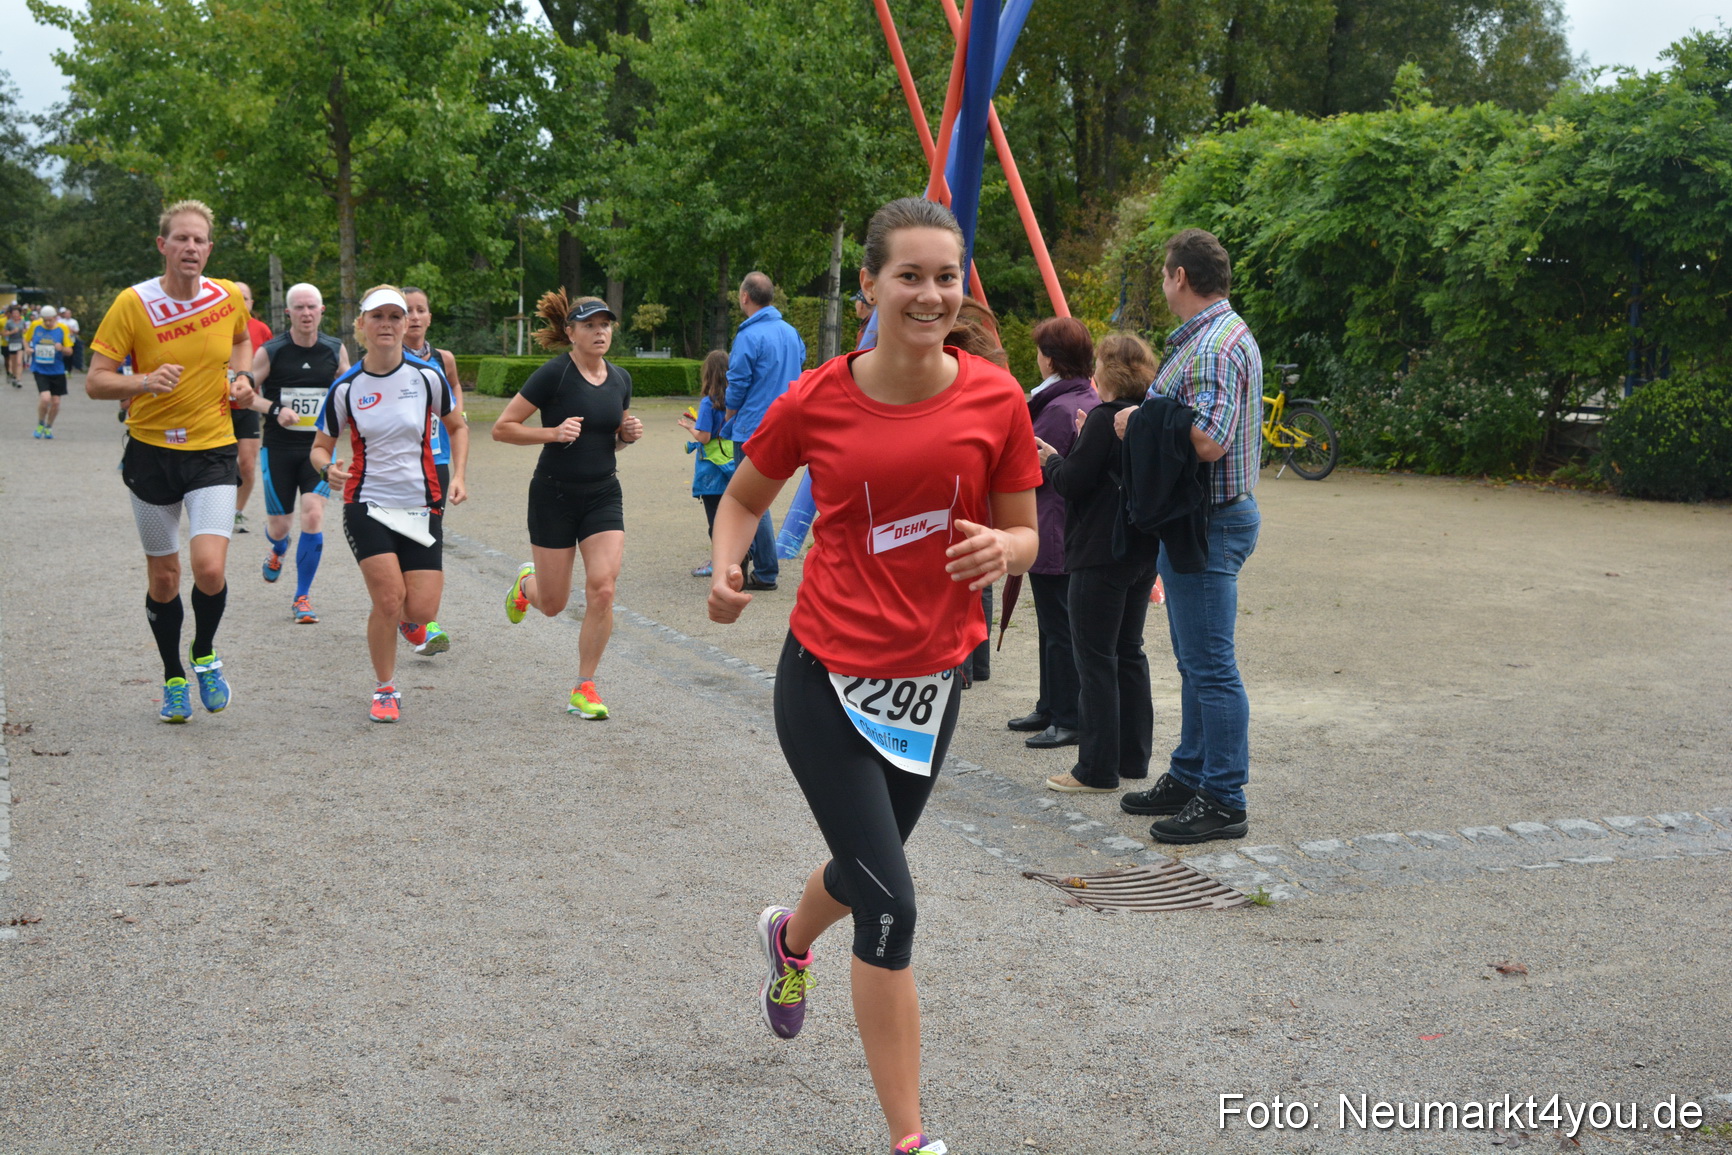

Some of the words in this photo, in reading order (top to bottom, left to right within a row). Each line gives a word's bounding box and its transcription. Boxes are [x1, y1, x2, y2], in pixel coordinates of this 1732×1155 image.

[156, 321, 197, 344] MAX
[200, 303, 236, 329] BÖGL
[291, 398, 320, 415] 657
[357, 395, 375, 405] tkn
[431, 419, 438, 436] 9
[894, 518, 928, 540] DEHN
[842, 677, 938, 726] 2298
[859, 719, 908, 753] Christine
